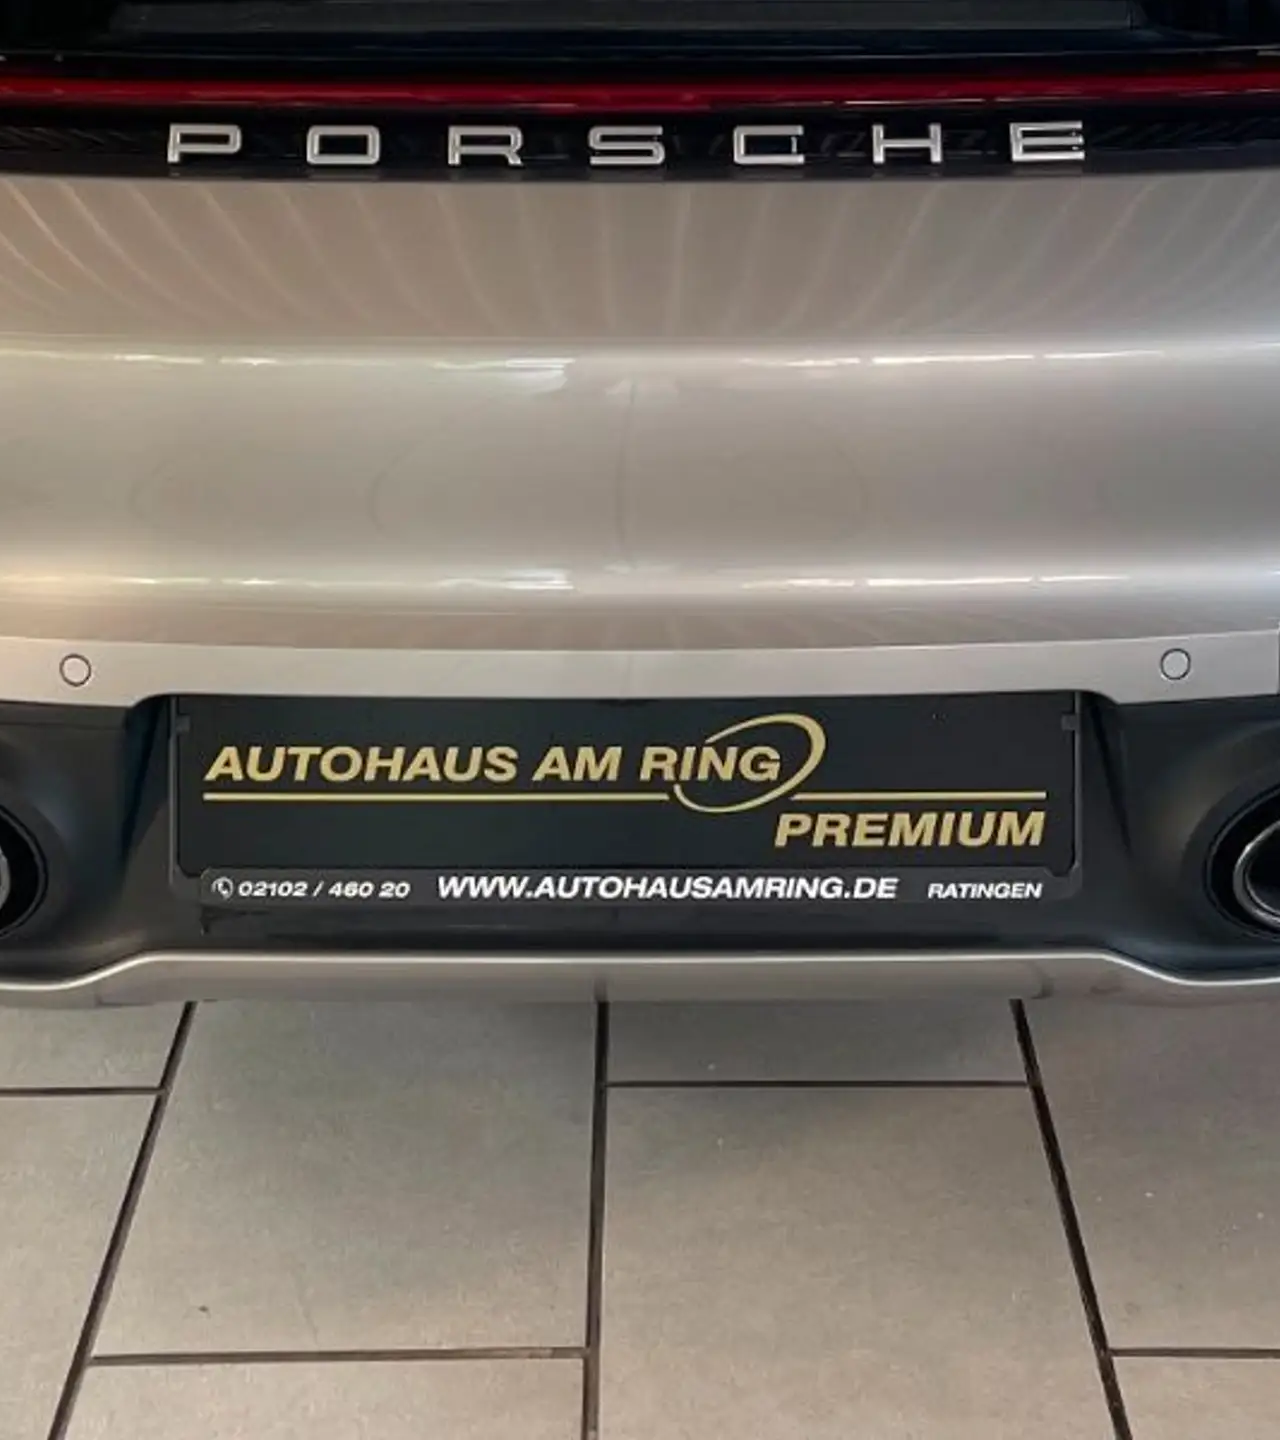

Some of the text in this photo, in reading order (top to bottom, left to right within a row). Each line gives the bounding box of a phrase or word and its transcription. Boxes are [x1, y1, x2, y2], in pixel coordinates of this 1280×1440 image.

[166, 120, 1086, 166] PORSCHE
[204, 746, 782, 782] AUTOHAUS AM RING
[774, 811, 1047, 848] PREMIUM
[238, 881, 308, 898] 02102
[327, 881, 375, 898] 460
[378, 881, 411, 898] 20
[437, 875, 900, 900] WWW.AUTOHAUSAMRING.DE
[927, 882, 1043, 900] RATINGEN
